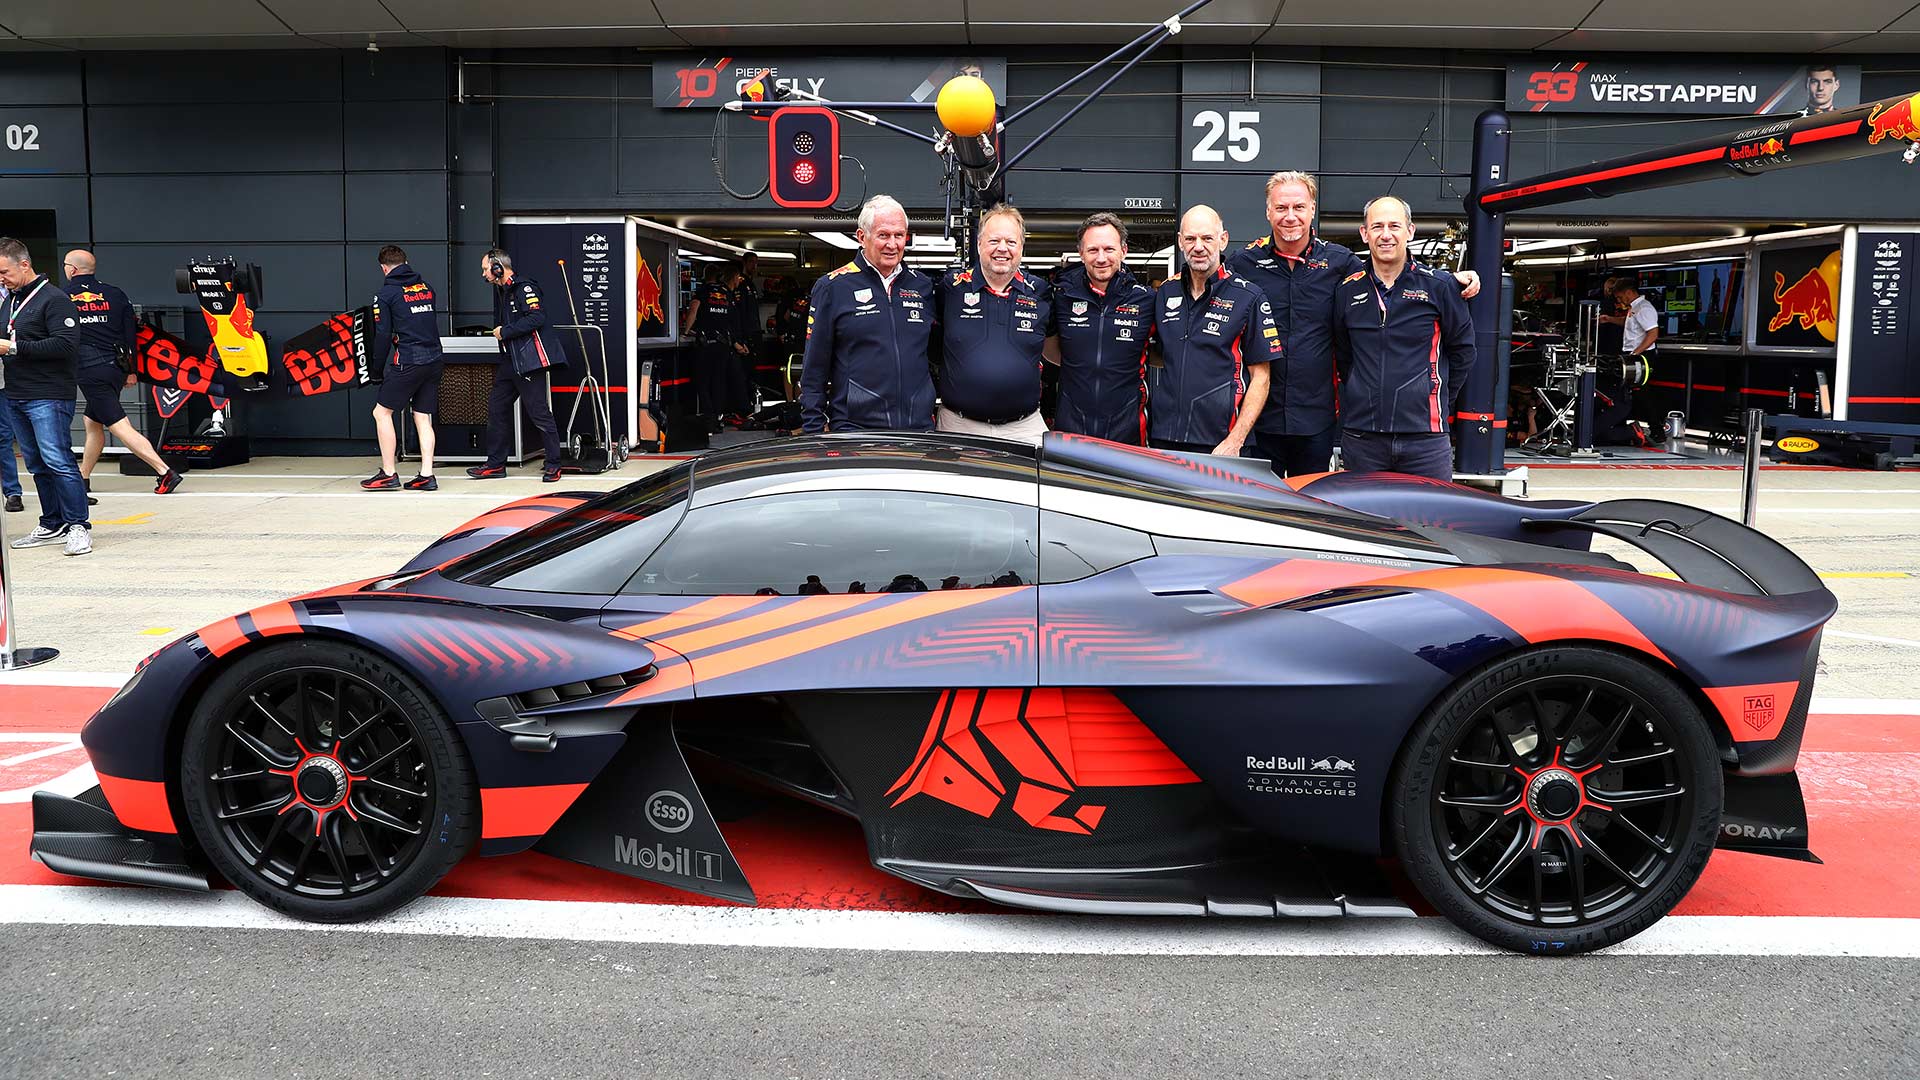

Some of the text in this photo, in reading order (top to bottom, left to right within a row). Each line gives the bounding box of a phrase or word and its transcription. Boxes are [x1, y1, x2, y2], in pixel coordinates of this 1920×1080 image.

[676, 69, 718, 98] 10
[1590, 73, 1617, 83] MAX
[1525, 71, 1578, 102] 33
[1590, 83, 1757, 103] VERSTAPPEN
[6, 124, 40, 150] 02
[1192, 110, 1261, 163] 25
[1730, 142, 1759, 160] Red Bull
[1124, 199, 1162, 208] OLIVER
[403, 290, 433, 303] Red Bull
[90, 301, 110, 311] Bull
[1204, 311, 1222, 321] Mobil
[354, 332, 370, 384] Mobil
[1788, 440, 1814, 449] RAUCH
[1341, 554, 1360, 562] CRACK
[1361, 557, 1382, 565] UNDER
[1383, 559, 1412, 568] PRESSURE
[1746, 698, 1771, 710] TAG
[1745, 711, 1773, 728] HEUER
[1246, 756, 1305, 771] Red Bull
[1247, 777, 1357, 789] ADVANCED
[1247, 785, 1356, 797] TECHNOLOGIES
[652, 799, 687, 822] Esso
[614, 834, 691, 877] Mobil
